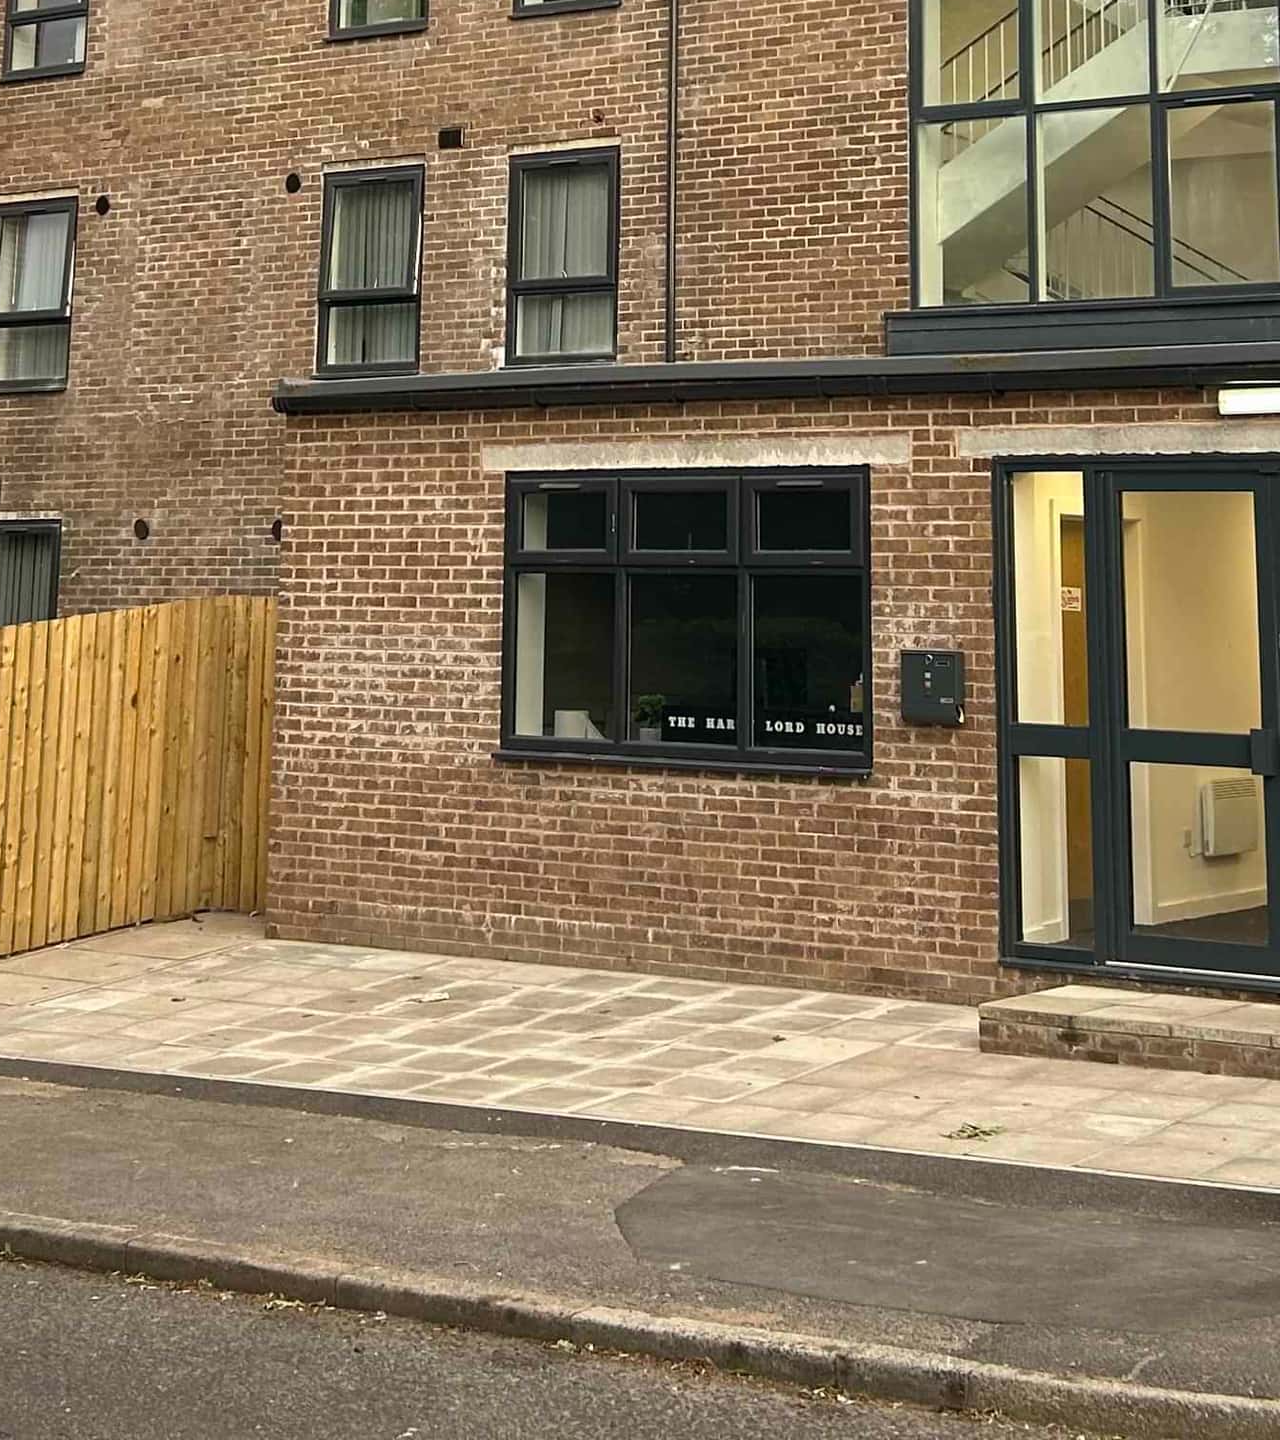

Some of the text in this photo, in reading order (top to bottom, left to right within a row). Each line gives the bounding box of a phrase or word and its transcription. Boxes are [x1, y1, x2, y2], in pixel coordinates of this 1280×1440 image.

[668, 716, 696, 729] THE
[765, 720, 805, 734] LORD
[815, 723, 864, 737] HOUSE
